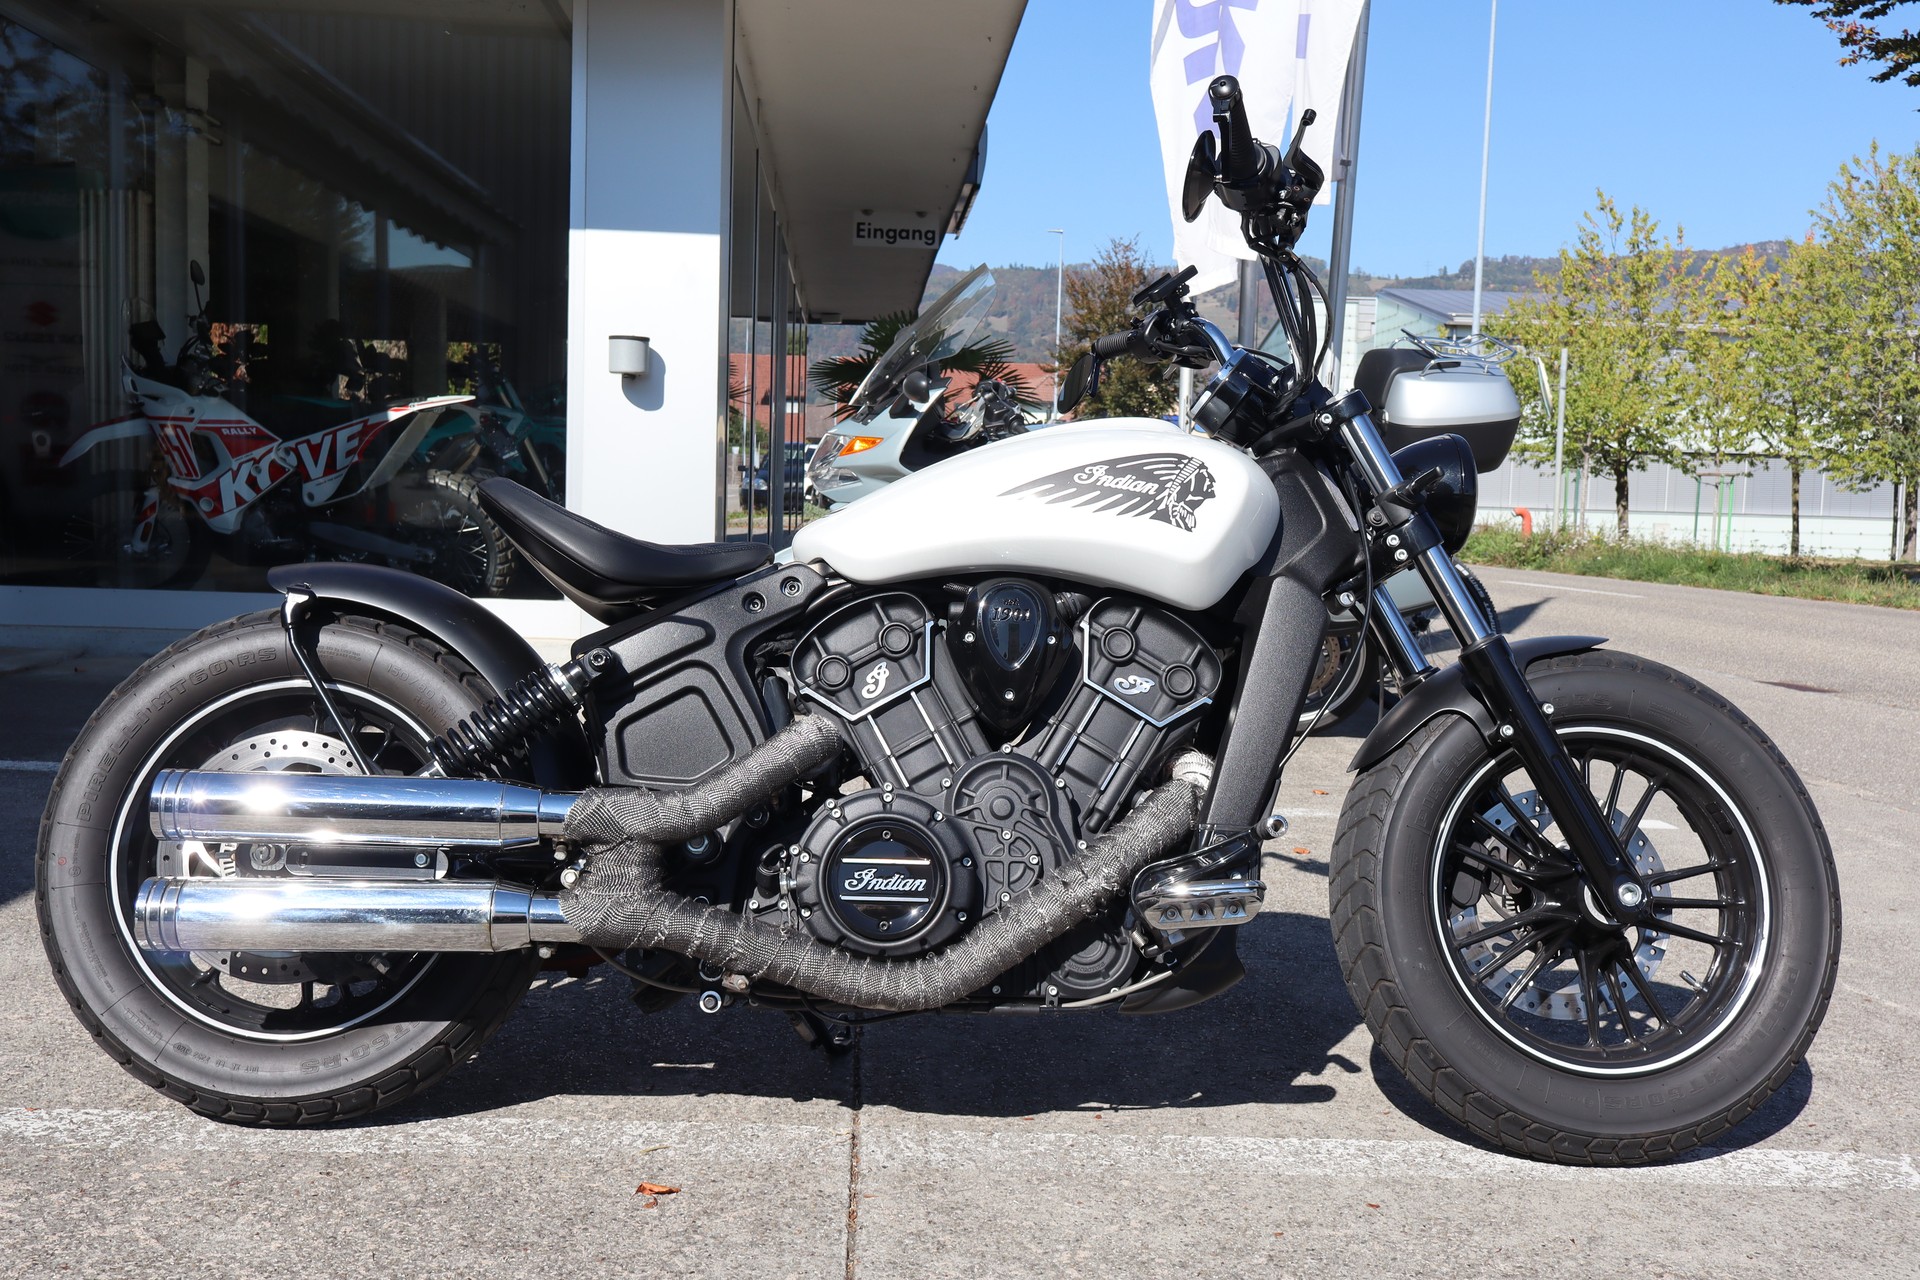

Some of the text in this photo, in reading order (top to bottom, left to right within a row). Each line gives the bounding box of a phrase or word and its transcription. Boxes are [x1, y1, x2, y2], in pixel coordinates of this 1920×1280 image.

[856, 222, 936, 246] Eingang
[221, 427, 257, 436] RALLY
[219, 424, 365, 513] KOVE
[1073, 465, 1160, 495] Indian
[992, 607, 1030, 621] 1901
[76, 708, 148, 821] PIRELLI
[236, 647, 278, 667] RS
[1416, 736, 1481, 828] PIRELL
[844, 868, 927, 891] Indian
